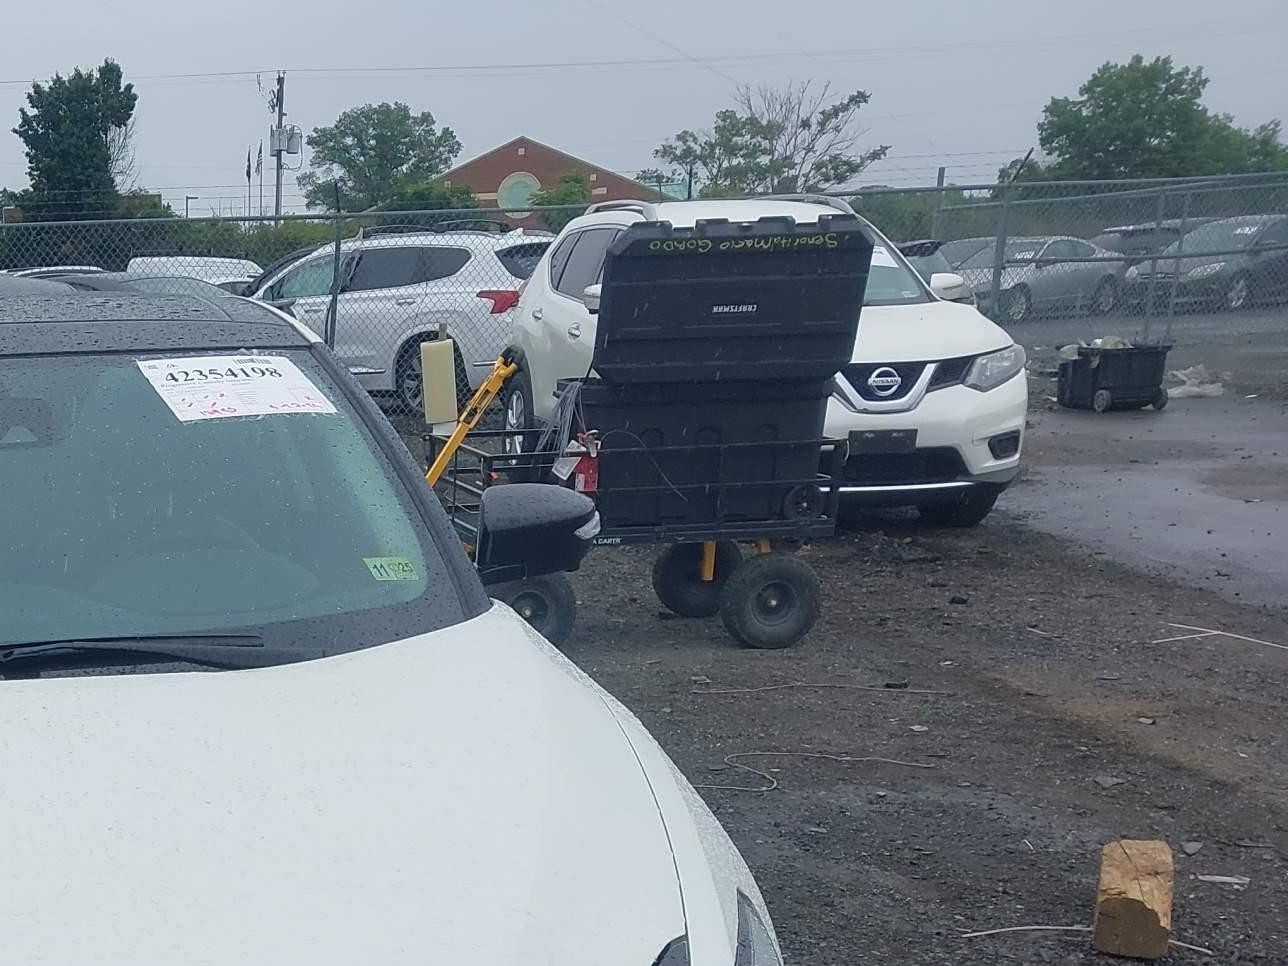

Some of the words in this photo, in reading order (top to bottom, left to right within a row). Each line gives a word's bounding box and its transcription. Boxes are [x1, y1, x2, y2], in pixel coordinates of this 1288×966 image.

[712, 304, 758, 313] CRAFTSMAN
[165, 366, 283, 383] 42354198
[372, 563, 390, 577] 11
